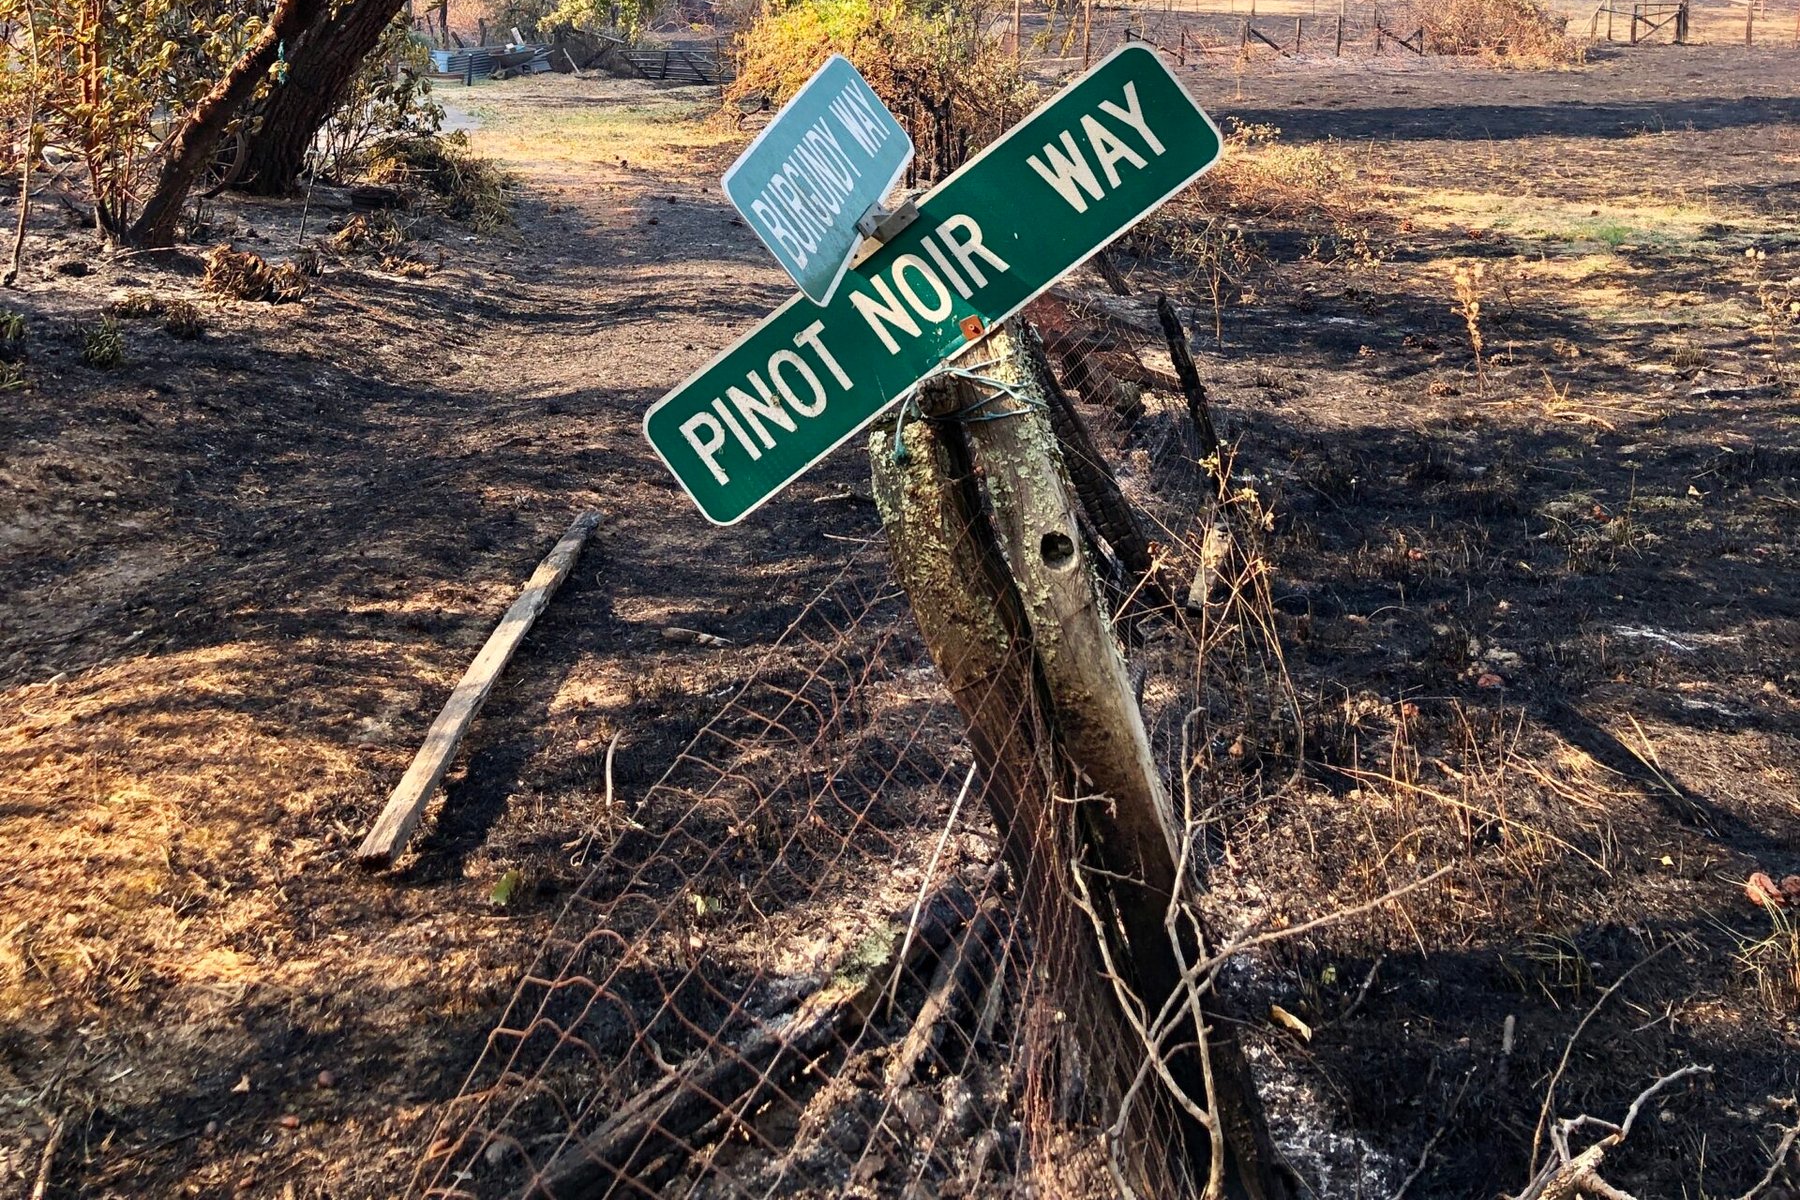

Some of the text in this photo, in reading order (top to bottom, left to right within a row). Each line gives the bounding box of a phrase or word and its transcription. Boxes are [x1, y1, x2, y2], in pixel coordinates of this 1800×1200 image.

[678, 80, 1167, 487] PINOT NOIR WAY
[751, 79, 891, 271] BURGUNDY WAY
